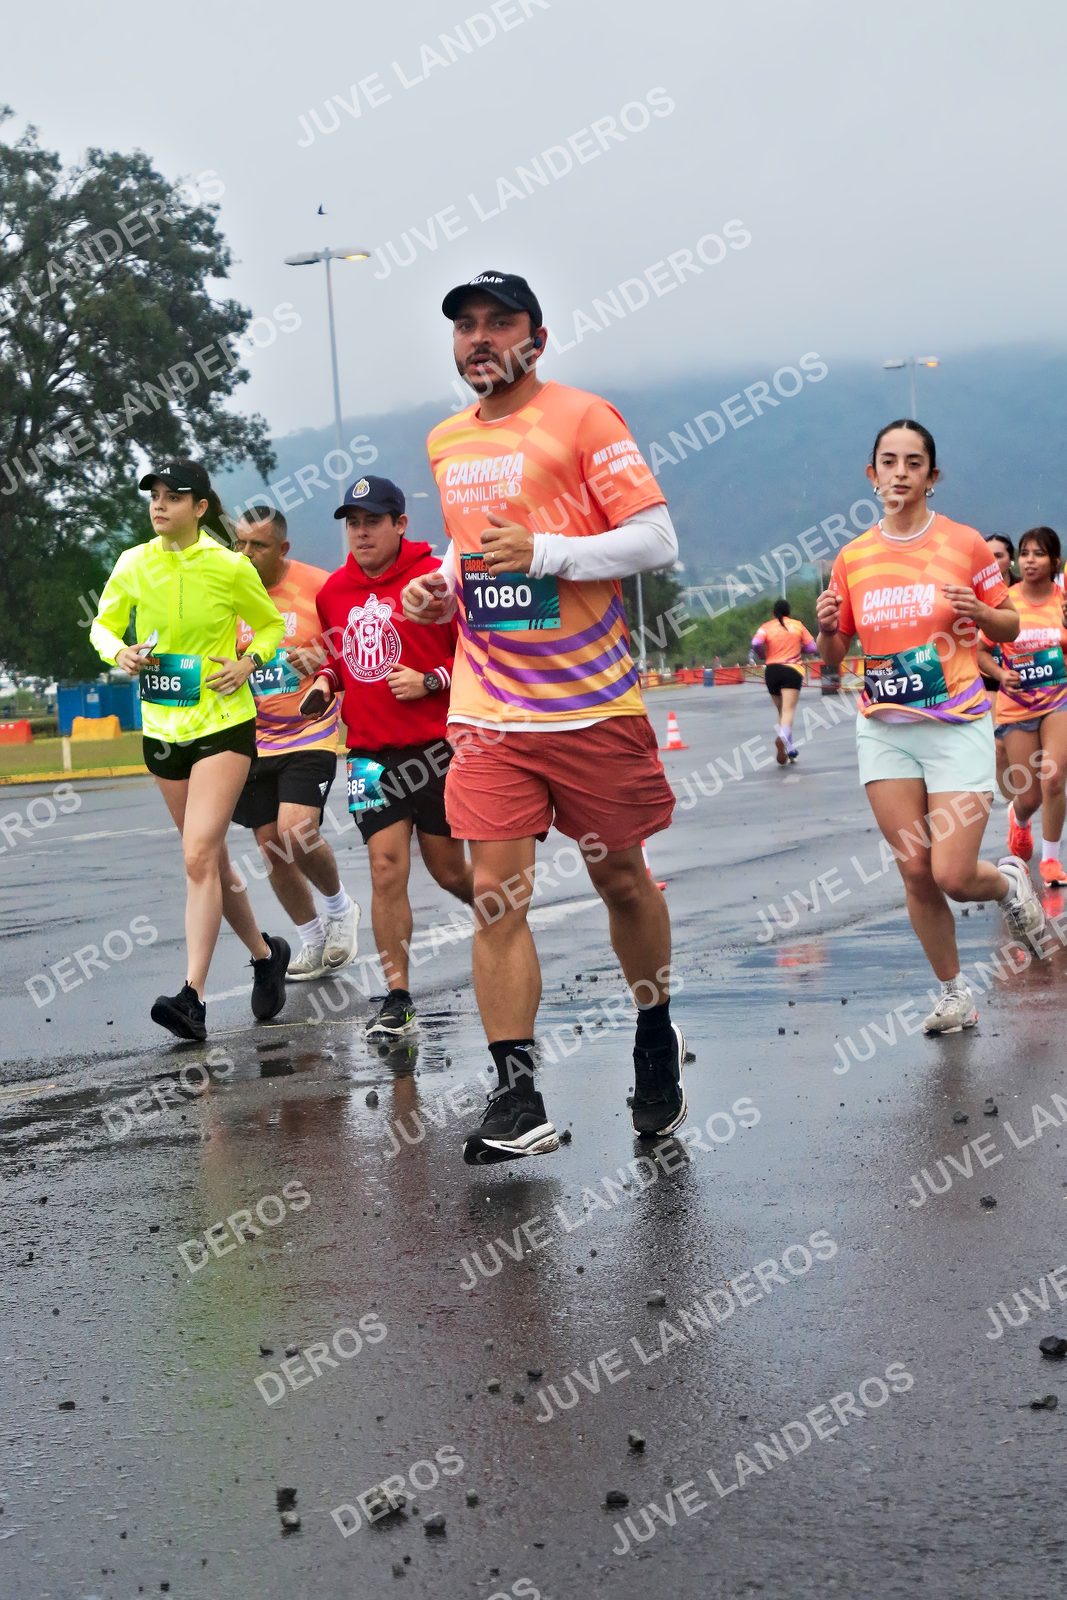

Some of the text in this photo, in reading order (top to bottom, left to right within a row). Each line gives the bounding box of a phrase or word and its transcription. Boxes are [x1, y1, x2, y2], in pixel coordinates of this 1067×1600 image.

[446, 453, 524, 487] CARRERA
[446, 483, 505, 505] OMNILIFE
[464, 560, 489, 572] CARRE
[474, 585, 532, 609] 1080
[863, 584, 936, 611] CARRERA
[861, 605, 917, 626] OMNILIFE
[1014, 628, 1062, 642] ARRERA
[180, 658, 196, 669] 10K
[914, 648, 932, 664] 10K
[249, 667, 284, 684] 1547
[1020, 664, 1054, 682] 1290
[145, 674, 182, 692] 1386
[875, 673, 924, 697] 1673
